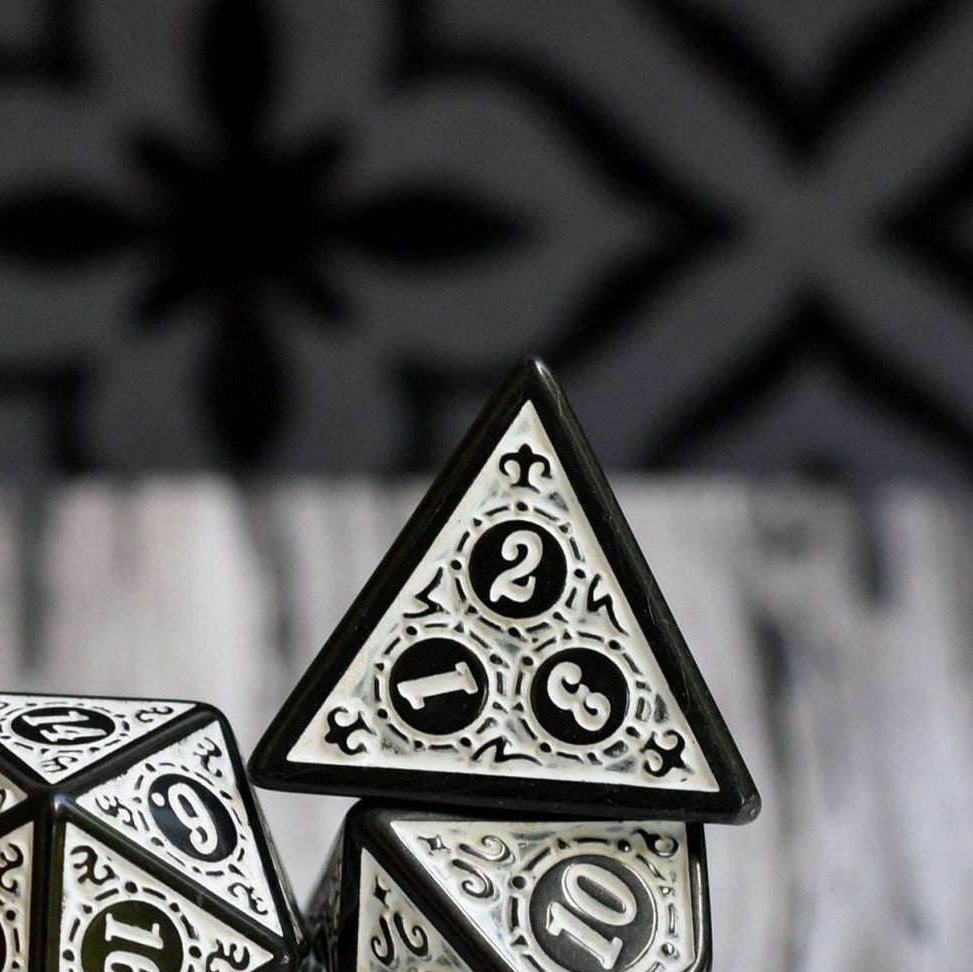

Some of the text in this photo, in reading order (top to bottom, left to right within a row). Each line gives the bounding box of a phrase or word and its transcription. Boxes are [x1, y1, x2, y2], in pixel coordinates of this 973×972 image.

[489, 529, 543, 603] 2
[397, 661, 479, 711] 1
[547, 661, 612, 733] 3
[21, 710, 107, 742] 14
[546, 862, 637, 971] 10
